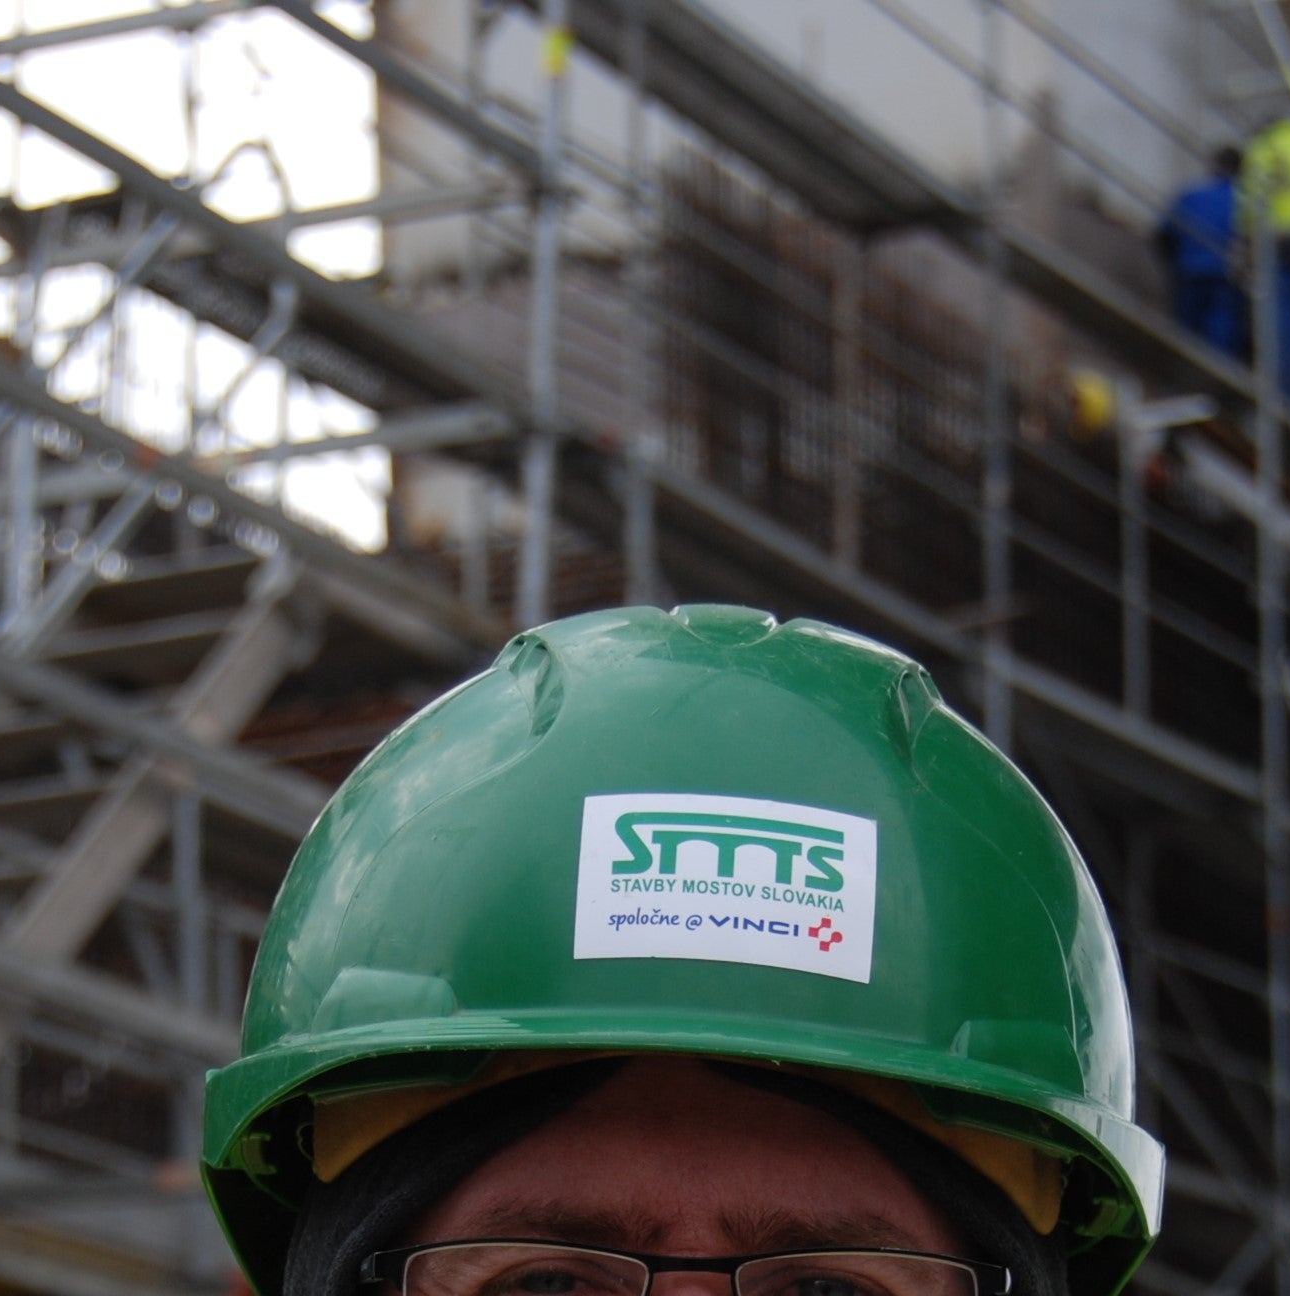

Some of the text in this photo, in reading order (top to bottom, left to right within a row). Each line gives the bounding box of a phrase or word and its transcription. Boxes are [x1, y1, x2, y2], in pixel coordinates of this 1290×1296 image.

[611, 879, 844, 913] STAVBY MOSTOV SLOVAKIA
[608, 907, 800, 937] spoločne @ VINCI
